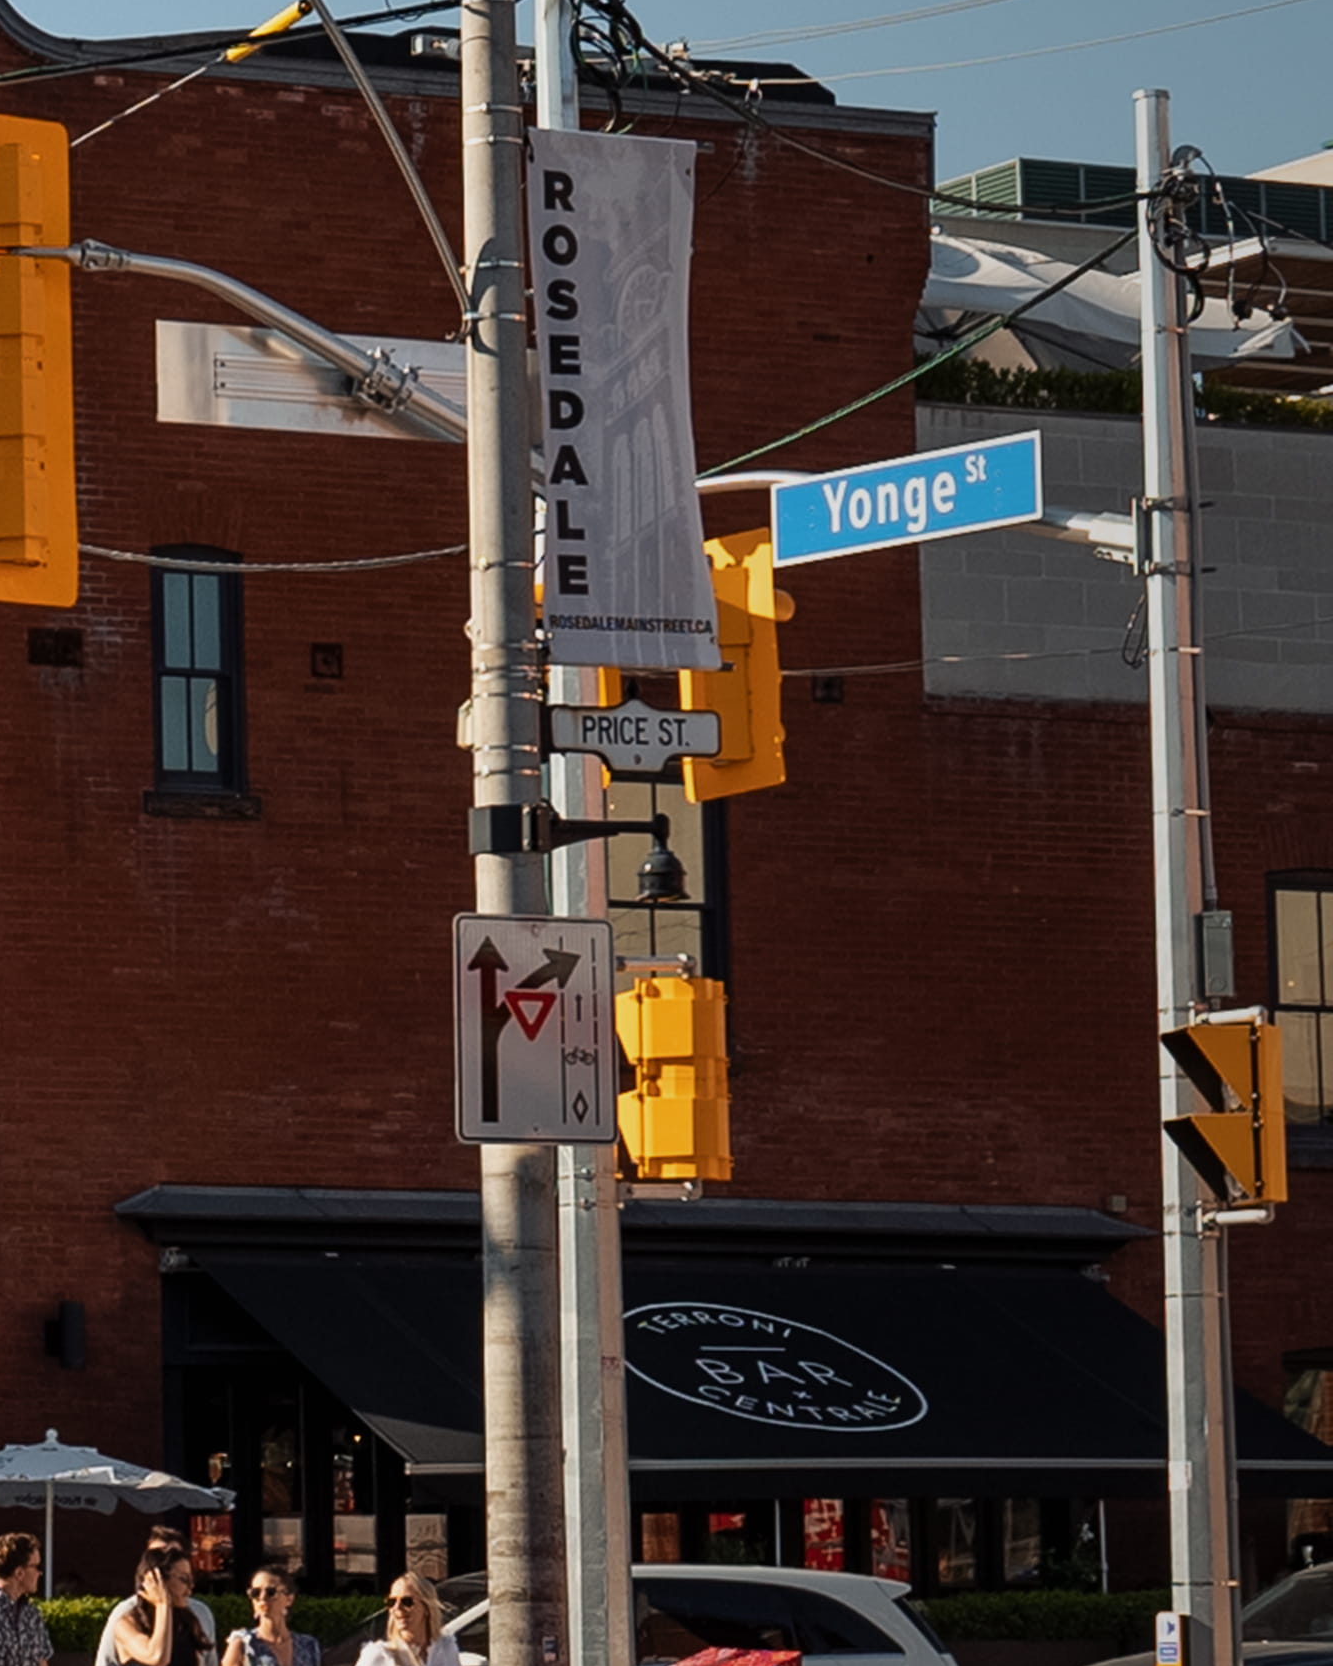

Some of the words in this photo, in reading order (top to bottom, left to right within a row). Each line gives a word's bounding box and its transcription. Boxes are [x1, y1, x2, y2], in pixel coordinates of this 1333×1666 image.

[542, 170, 589, 596] ROSEDALE
[822, 471, 957, 533] Yonge
[965, 454, 987, 482] St
[549, 614, 713, 633] ROSEDALEMAINSTREET.CA
[582, 715, 649, 745] PRICE
[658, 718, 690, 747] ST.
[637, 1310, 791, 1339] TERRONI
[695, 1358, 853, 1387] BAR
[698, 1385, 901, 1421] CENTRALE
